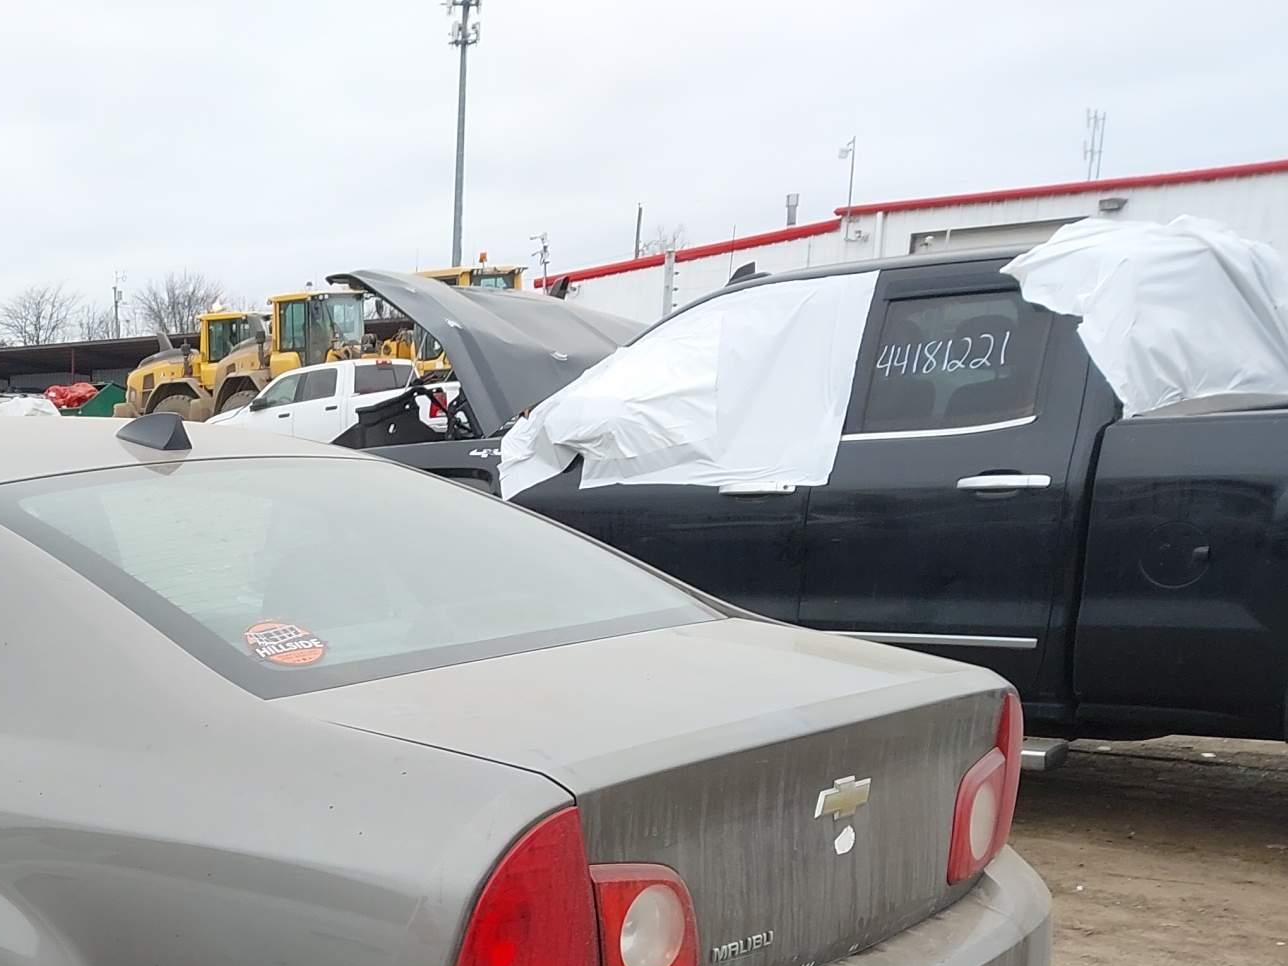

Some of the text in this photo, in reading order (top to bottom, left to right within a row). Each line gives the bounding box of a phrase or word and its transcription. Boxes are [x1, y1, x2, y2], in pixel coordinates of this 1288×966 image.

[876, 331, 1011, 377] 44181221
[255, 638, 324, 658] HILLSIDE
[712, 930, 774, 962] MALIBU
